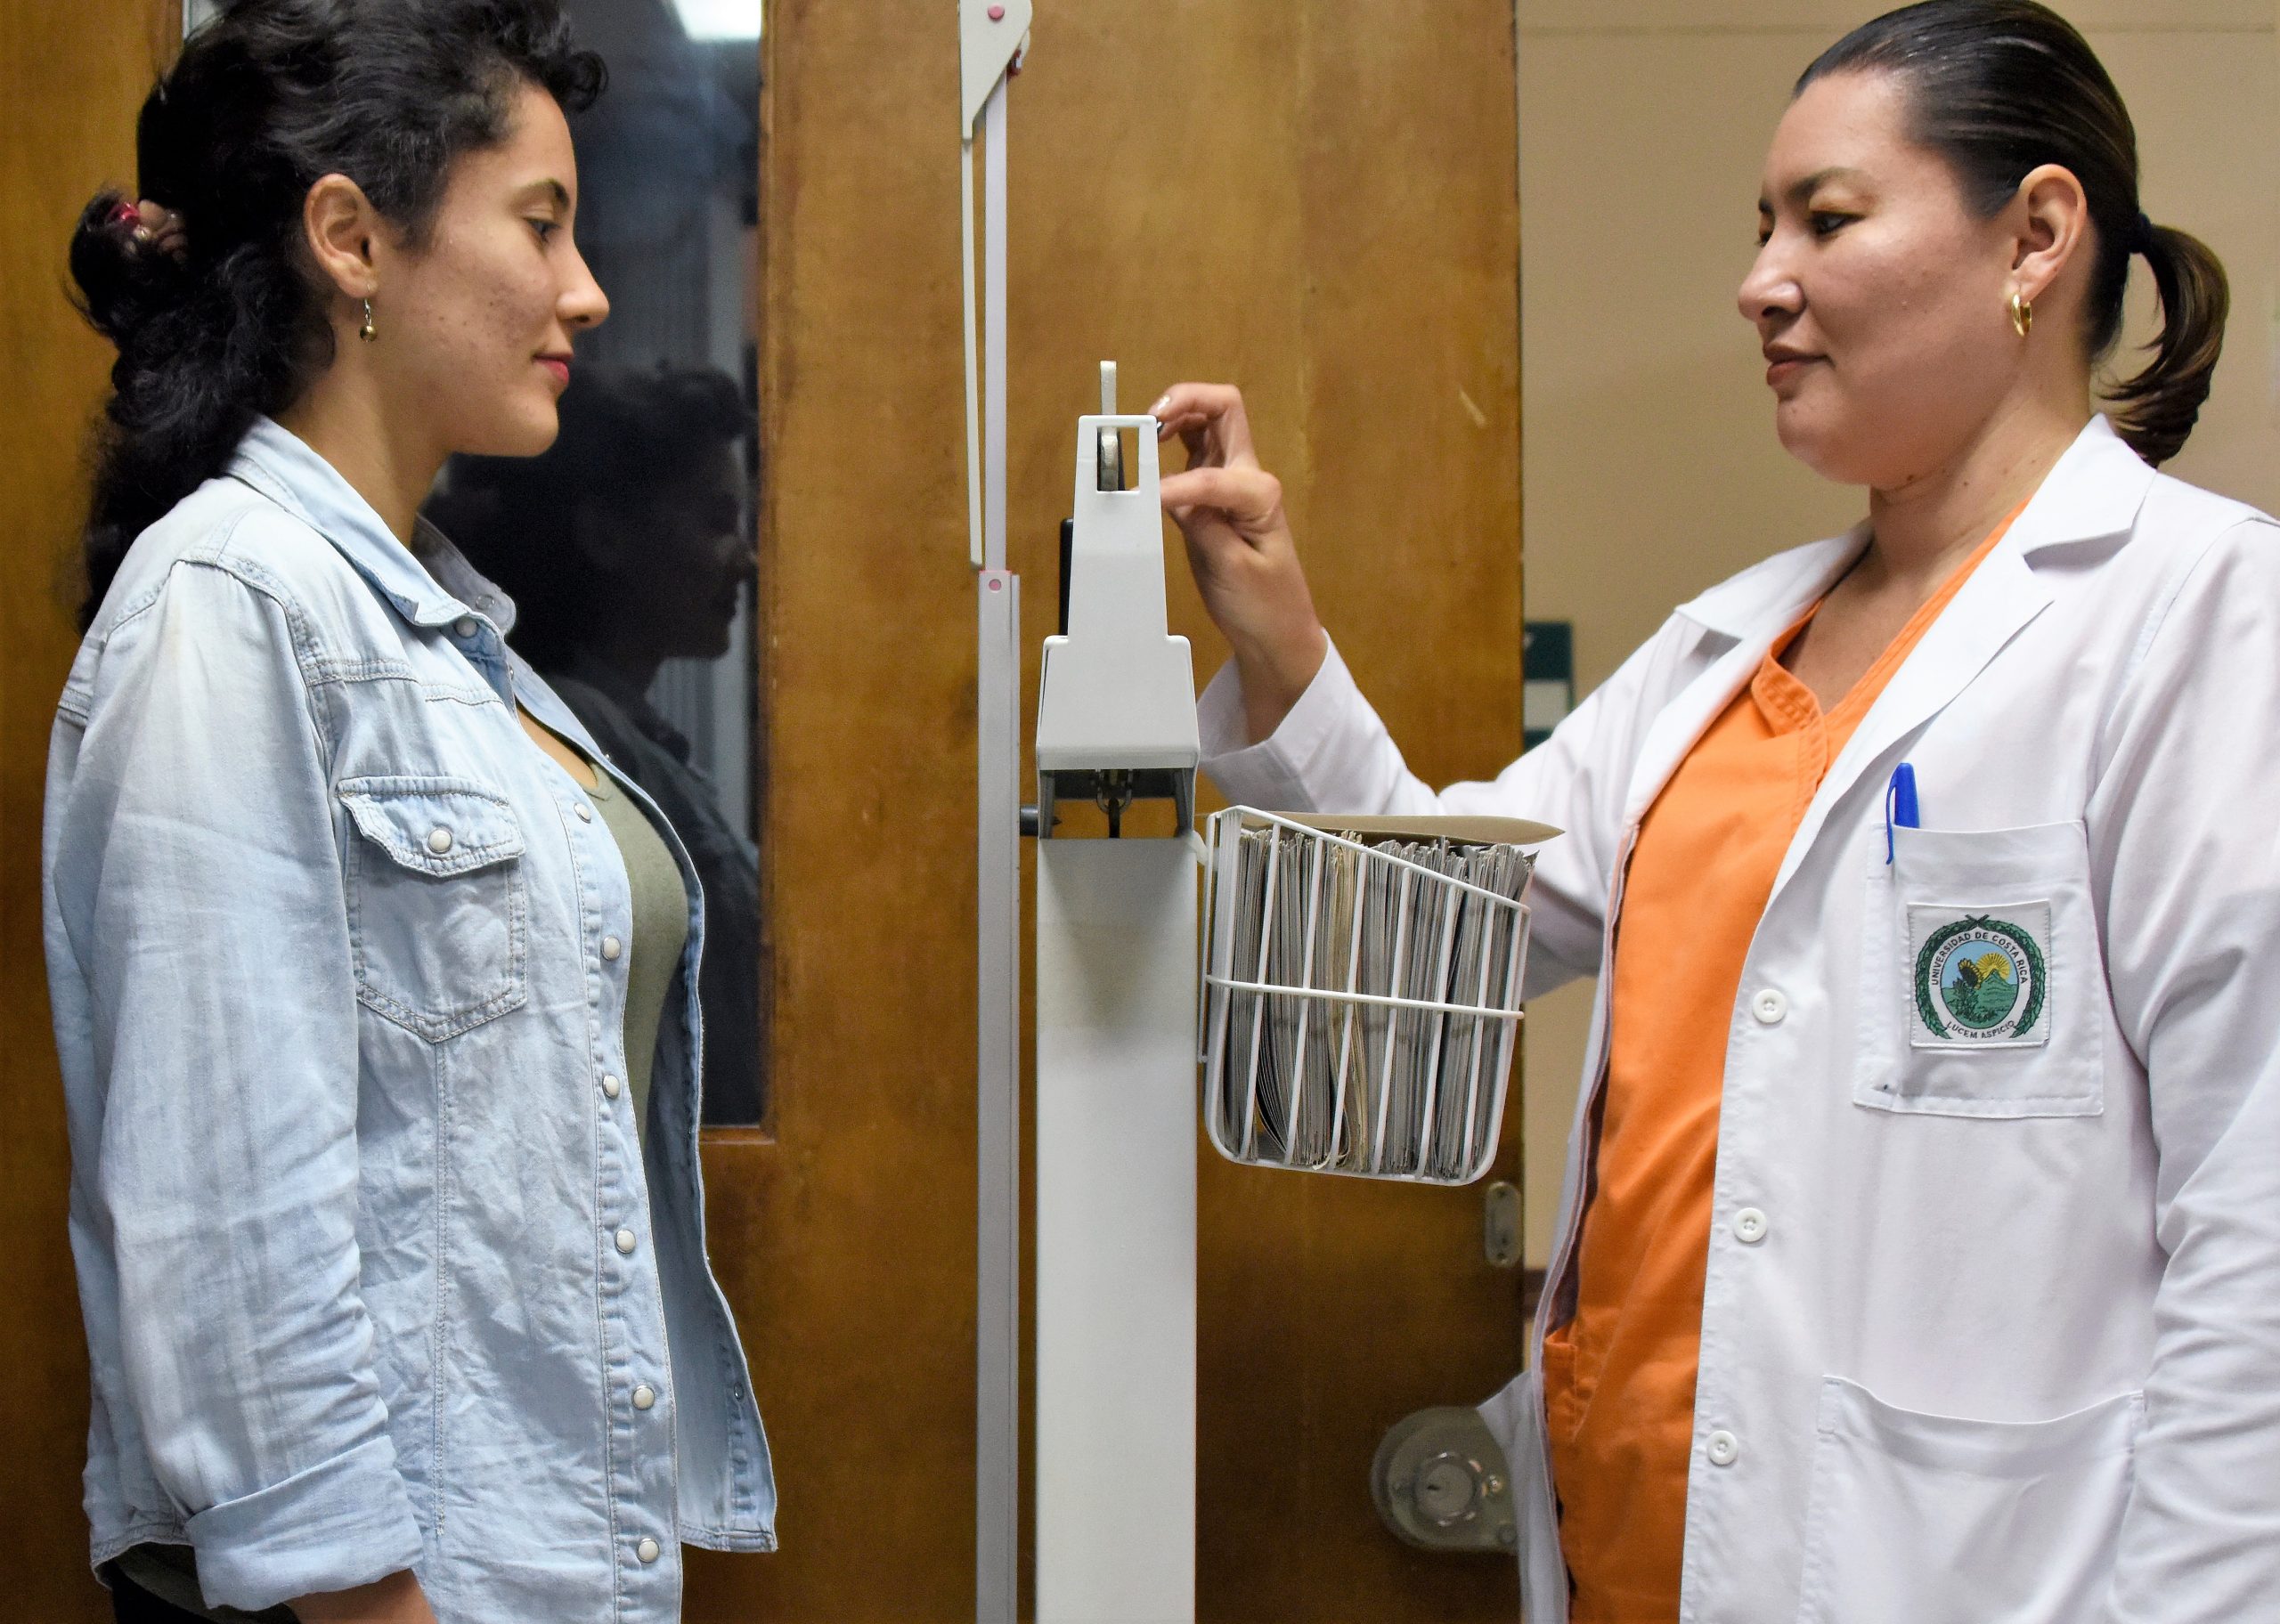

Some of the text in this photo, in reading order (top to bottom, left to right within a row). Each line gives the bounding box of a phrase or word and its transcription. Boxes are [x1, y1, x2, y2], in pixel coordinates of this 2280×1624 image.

[1931, 931, 2029, 986] UNIVERSIDAD DE COSTA RICA
[1946, 1020, 2015, 1039] LUCEM ASPICIO
